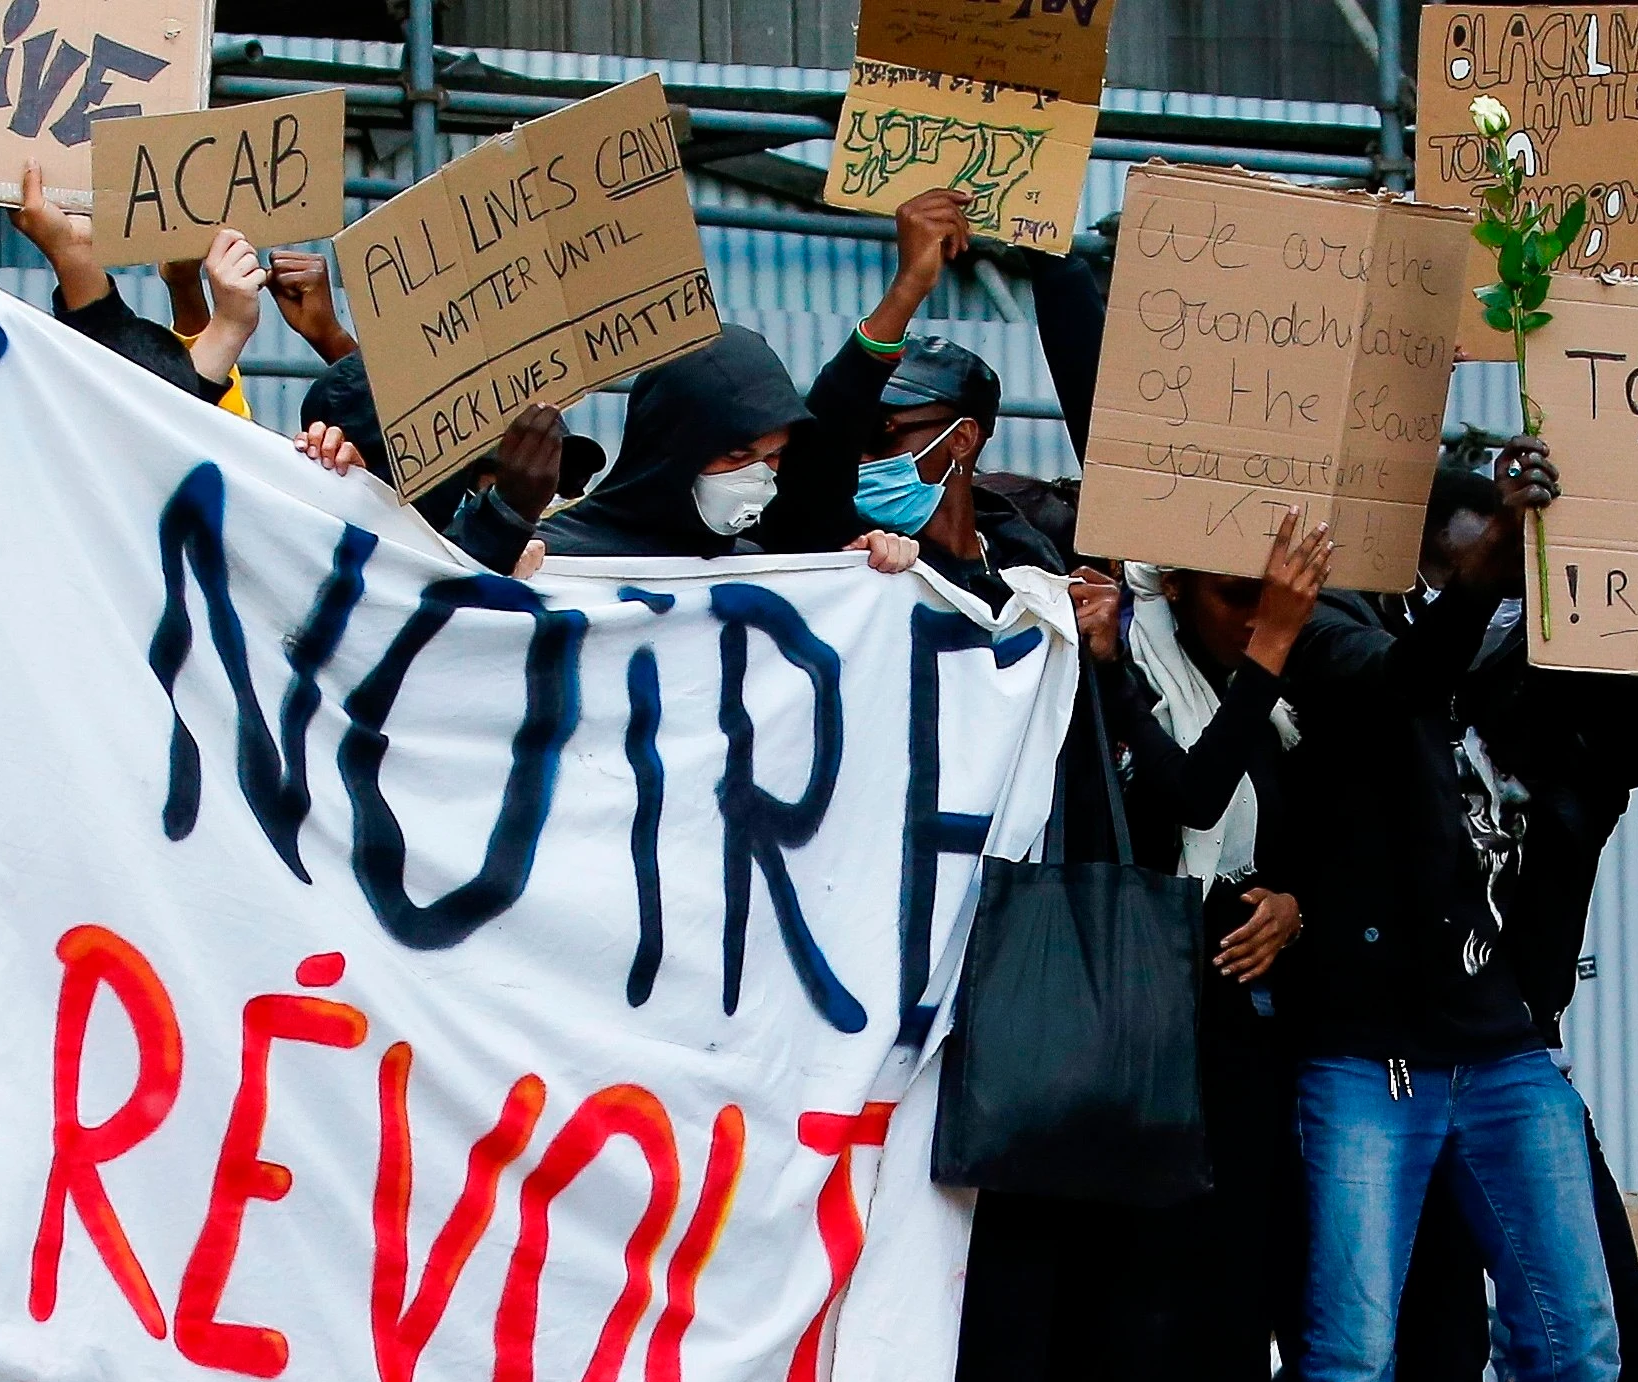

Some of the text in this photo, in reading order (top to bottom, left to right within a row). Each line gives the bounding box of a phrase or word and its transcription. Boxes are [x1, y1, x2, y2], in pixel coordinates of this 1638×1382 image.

[363, 219, 456, 317] ALL
[596, 114, 682, 189] CAN'T
[1138, 199, 1437, 295] We are the
[420, 257, 537, 357] MATTER
[391, 395, 489, 480] BLACK
[583, 272, 714, 362] MATTER
[1138, 366, 1191, 426] of
[1144, 443, 1221, 499] you
[150, 461, 1042, 1047] NOIRE
